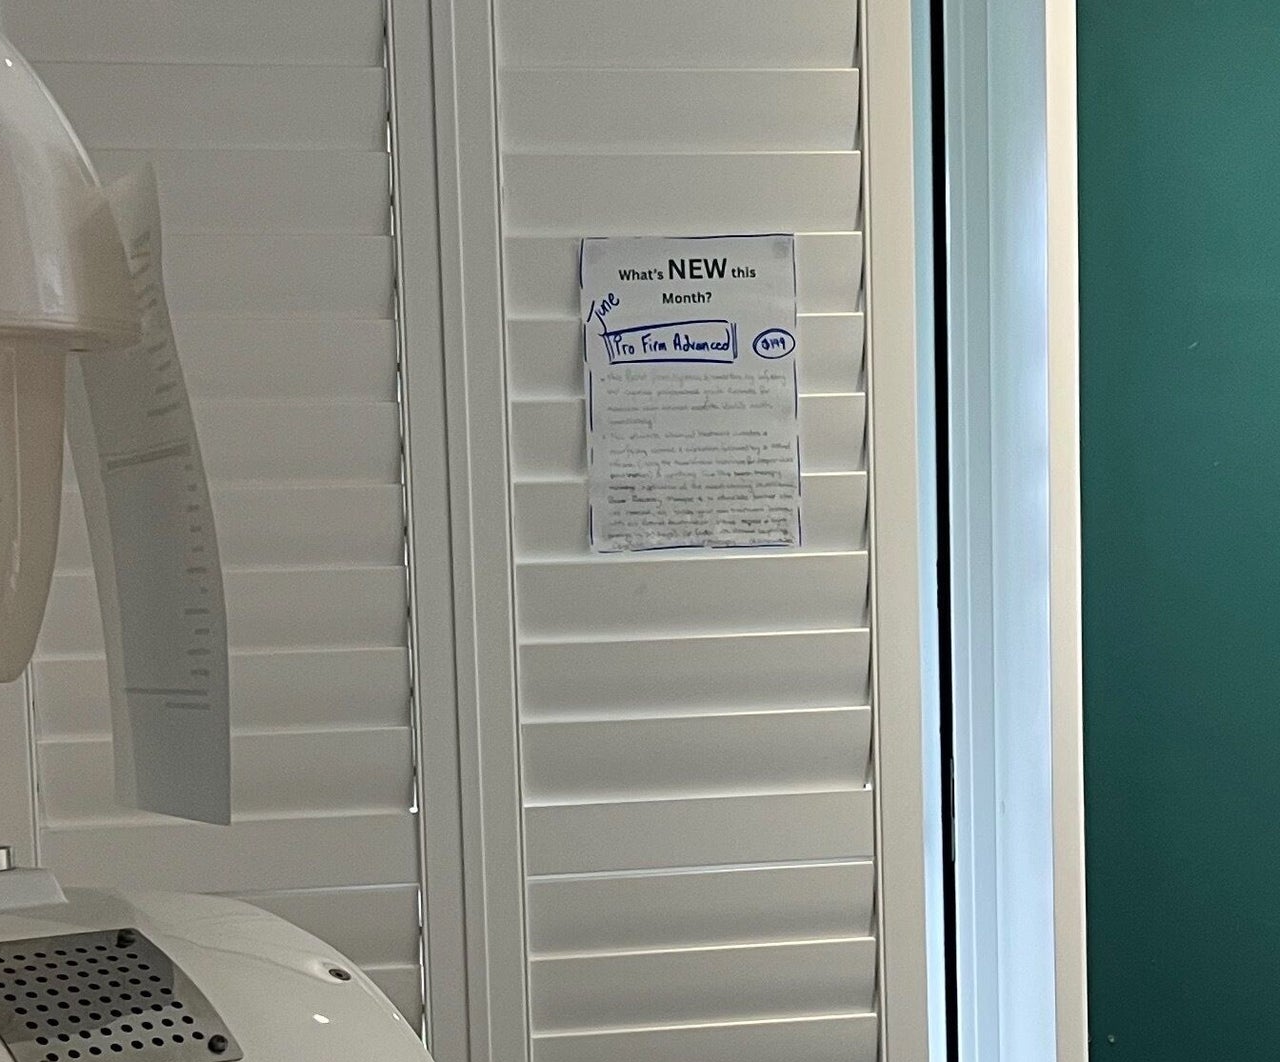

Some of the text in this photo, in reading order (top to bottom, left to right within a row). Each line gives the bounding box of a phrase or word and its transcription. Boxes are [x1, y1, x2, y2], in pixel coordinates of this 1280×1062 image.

[618, 258, 756, 281] What's NEW this
[662, 291, 712, 305] Month?
[613, 328, 731, 355] Pro Firm Advanced
